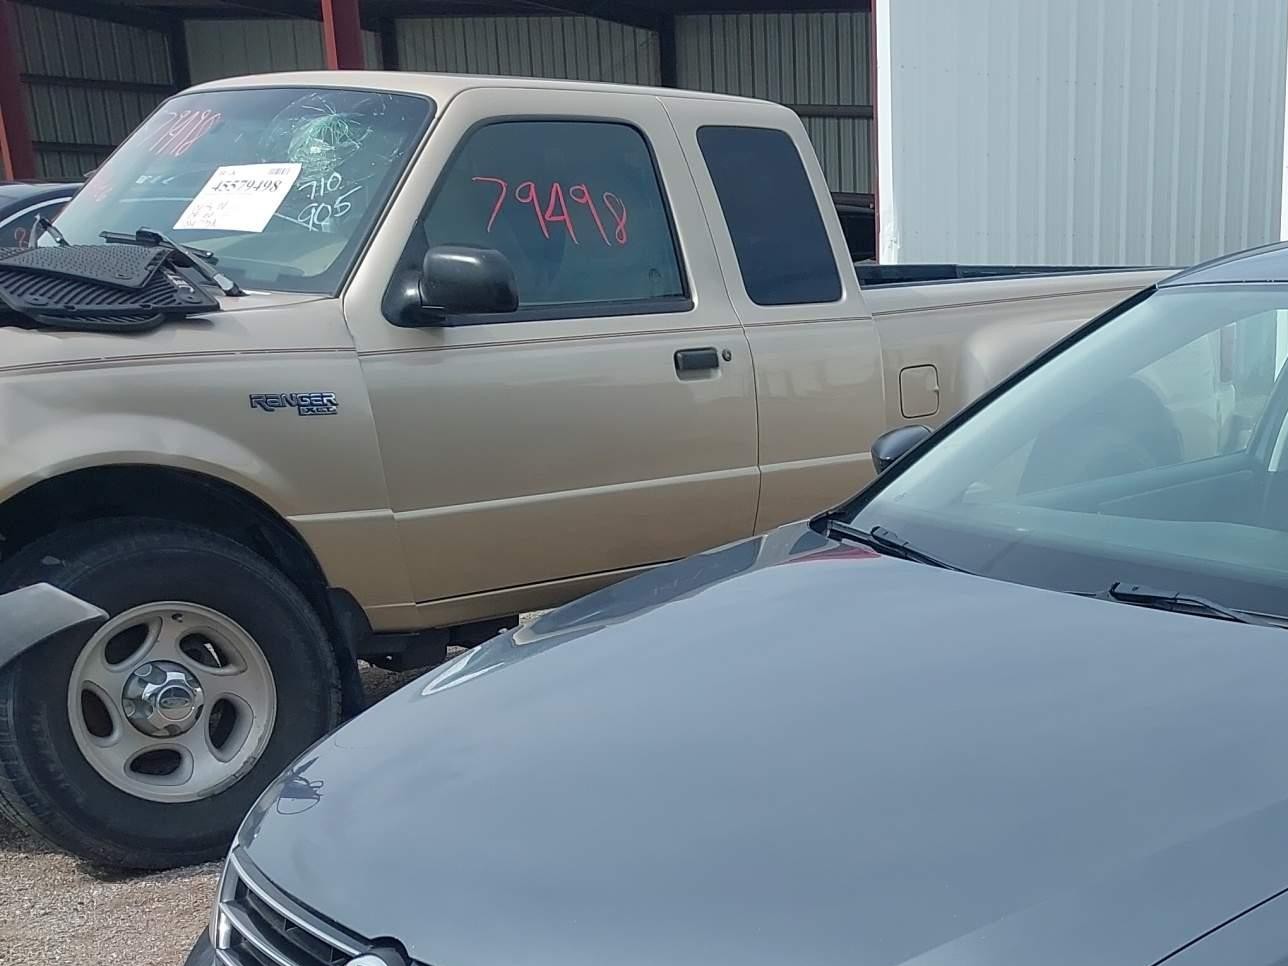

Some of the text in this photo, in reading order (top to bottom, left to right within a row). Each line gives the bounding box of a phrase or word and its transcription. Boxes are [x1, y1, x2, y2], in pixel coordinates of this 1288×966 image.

[211, 179, 283, 193] 45579498
[298, 186, 362, 231] 905
[472, 176, 627, 246] 79498
